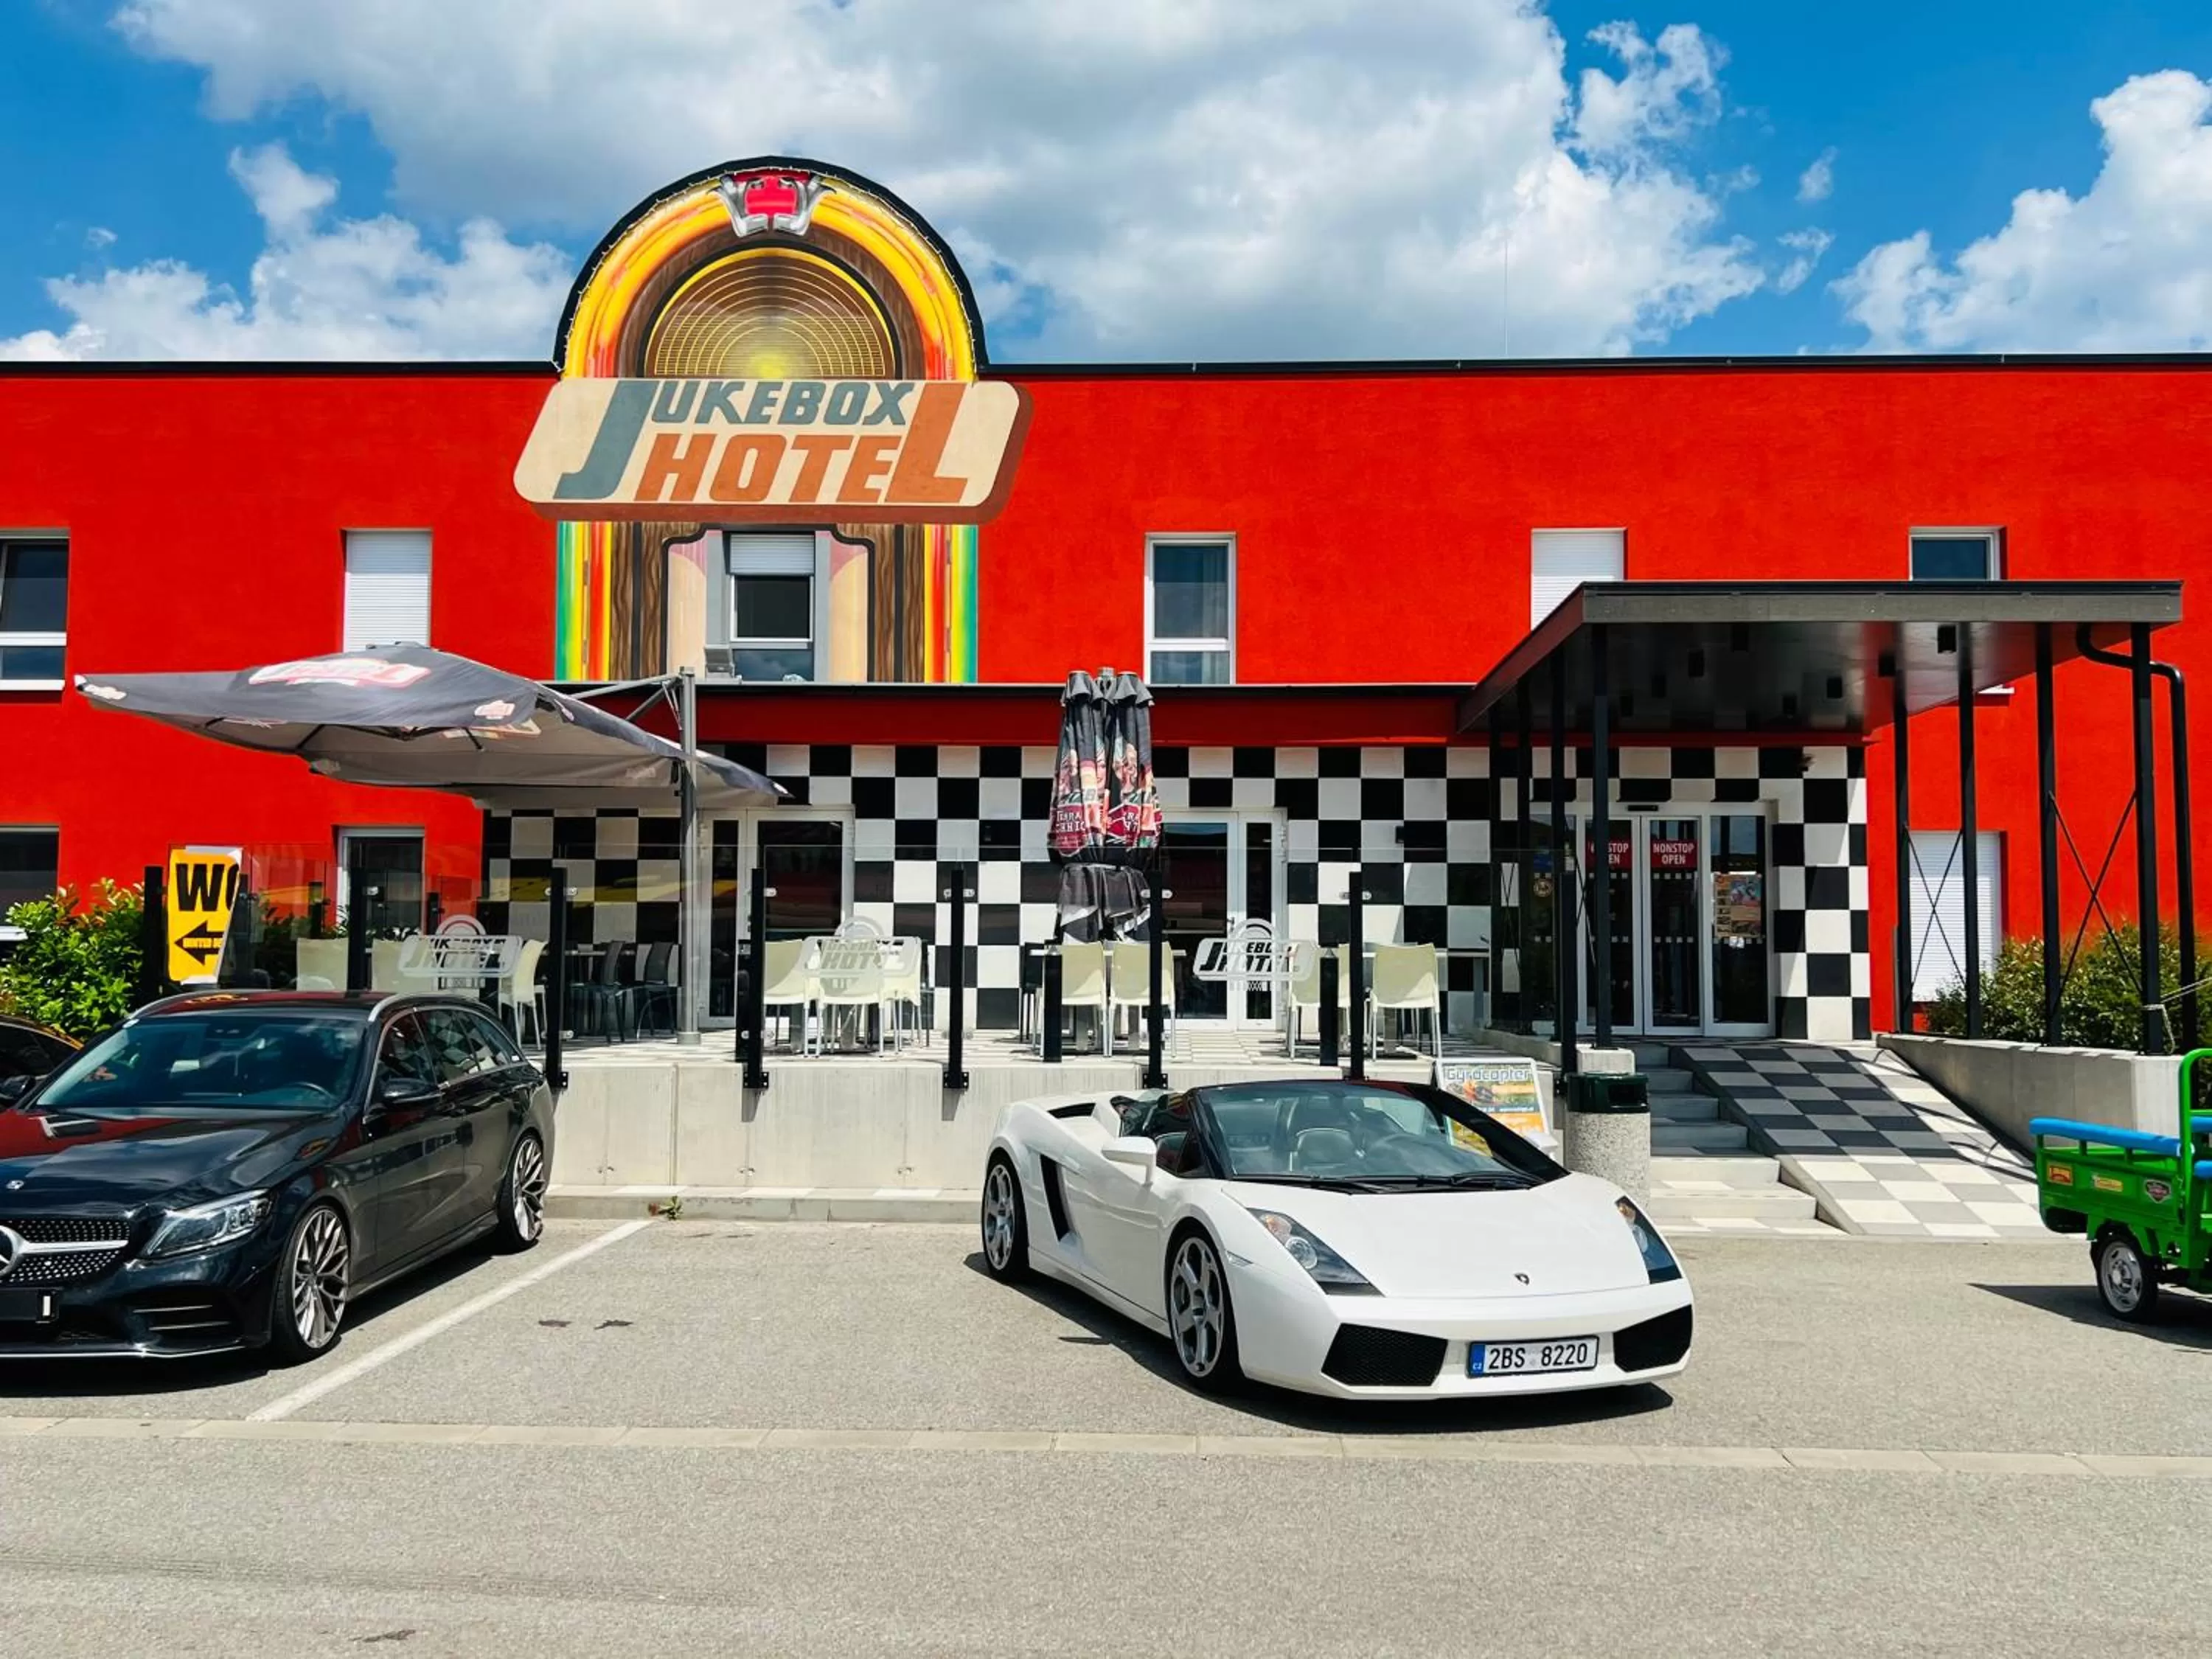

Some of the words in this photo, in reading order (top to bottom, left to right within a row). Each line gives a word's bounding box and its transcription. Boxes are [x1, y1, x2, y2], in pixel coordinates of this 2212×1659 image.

[553, 380, 914, 500] JUKEBOX
[633, 380, 969, 504] HOTEL
[1653, 843, 1695, 854] NONSTOP
[1662, 854, 1686, 865] OPEN
[1489, 1347, 1526, 1369] 2BS
[1541, 1343, 1587, 1366] 8220
